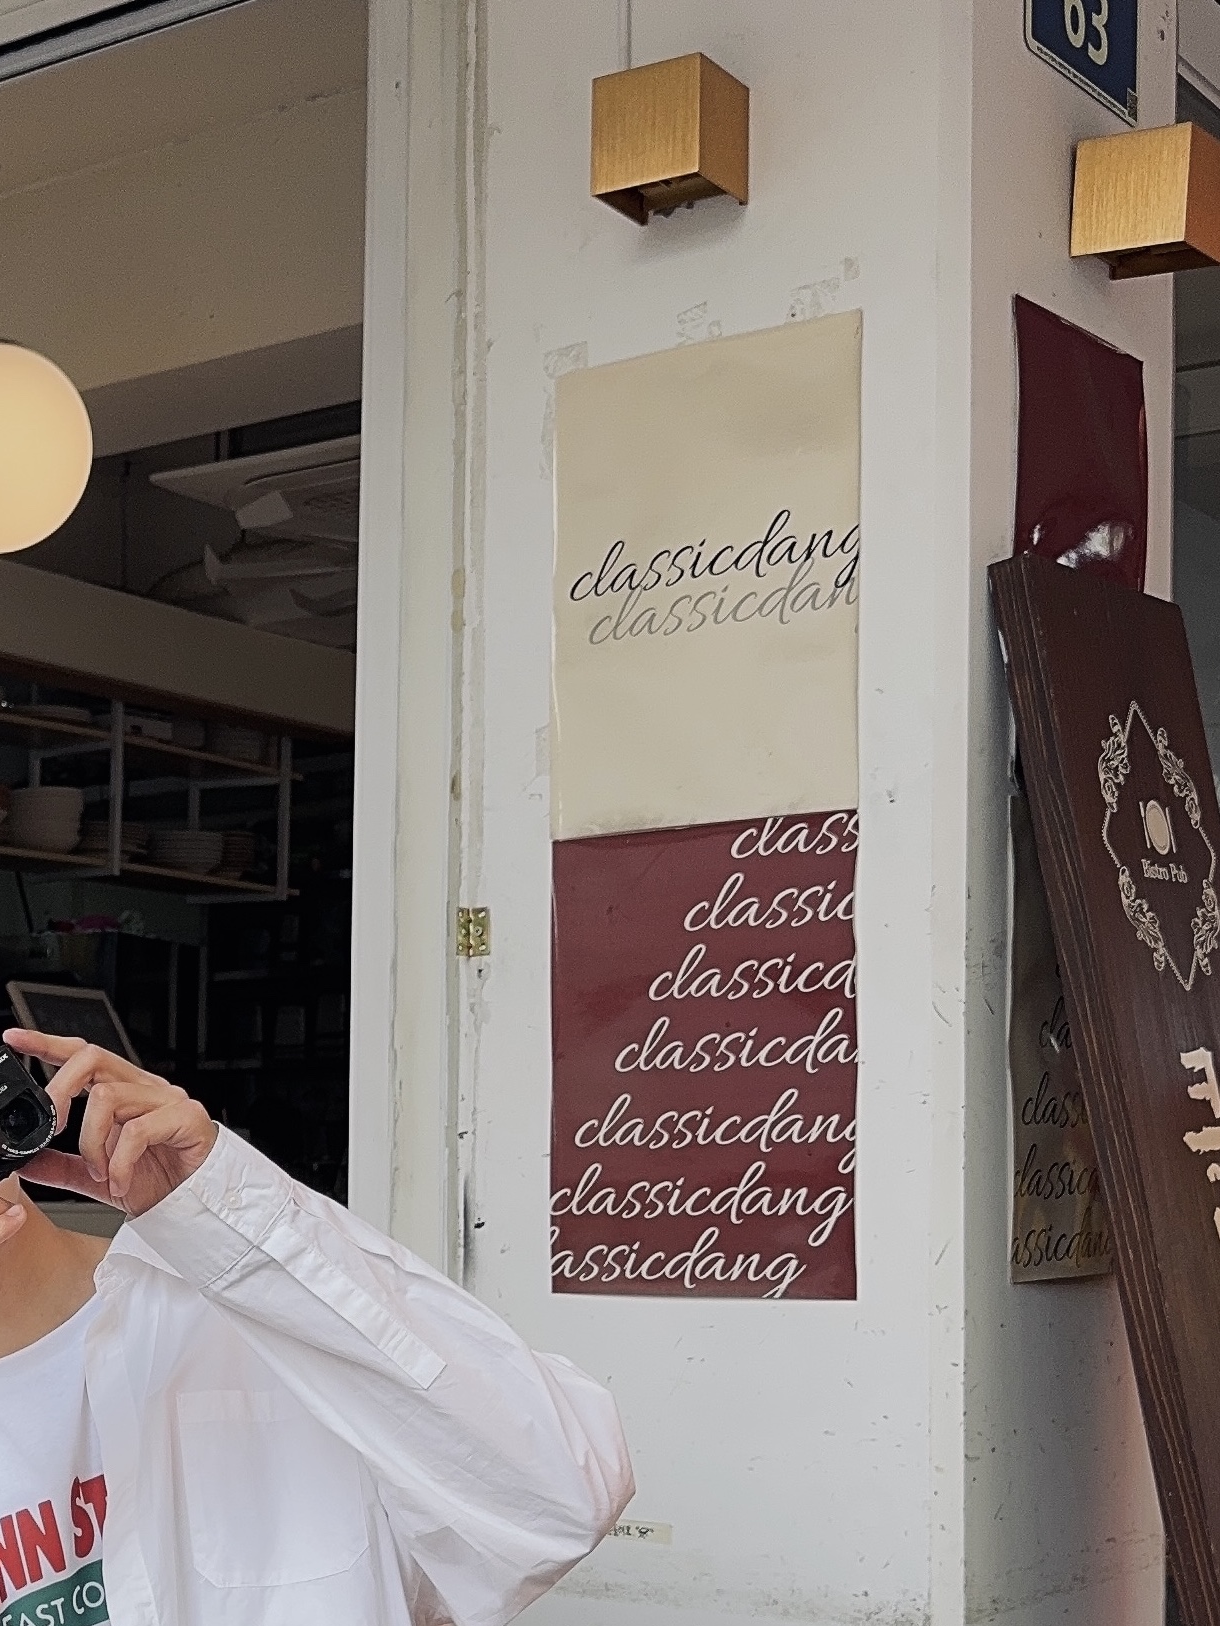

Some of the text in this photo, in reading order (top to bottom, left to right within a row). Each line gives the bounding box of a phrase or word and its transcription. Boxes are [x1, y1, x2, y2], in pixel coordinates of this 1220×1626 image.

[569, 508, 860, 602] classicdang
[588, 557, 860, 646] classicdan
[614, 1006, 860, 1074] classicda
[551, 1160, 854, 1248] classicdang
[551, 1225, 807, 1299] assicdang
[73, 1580, 106, 1615] CO
